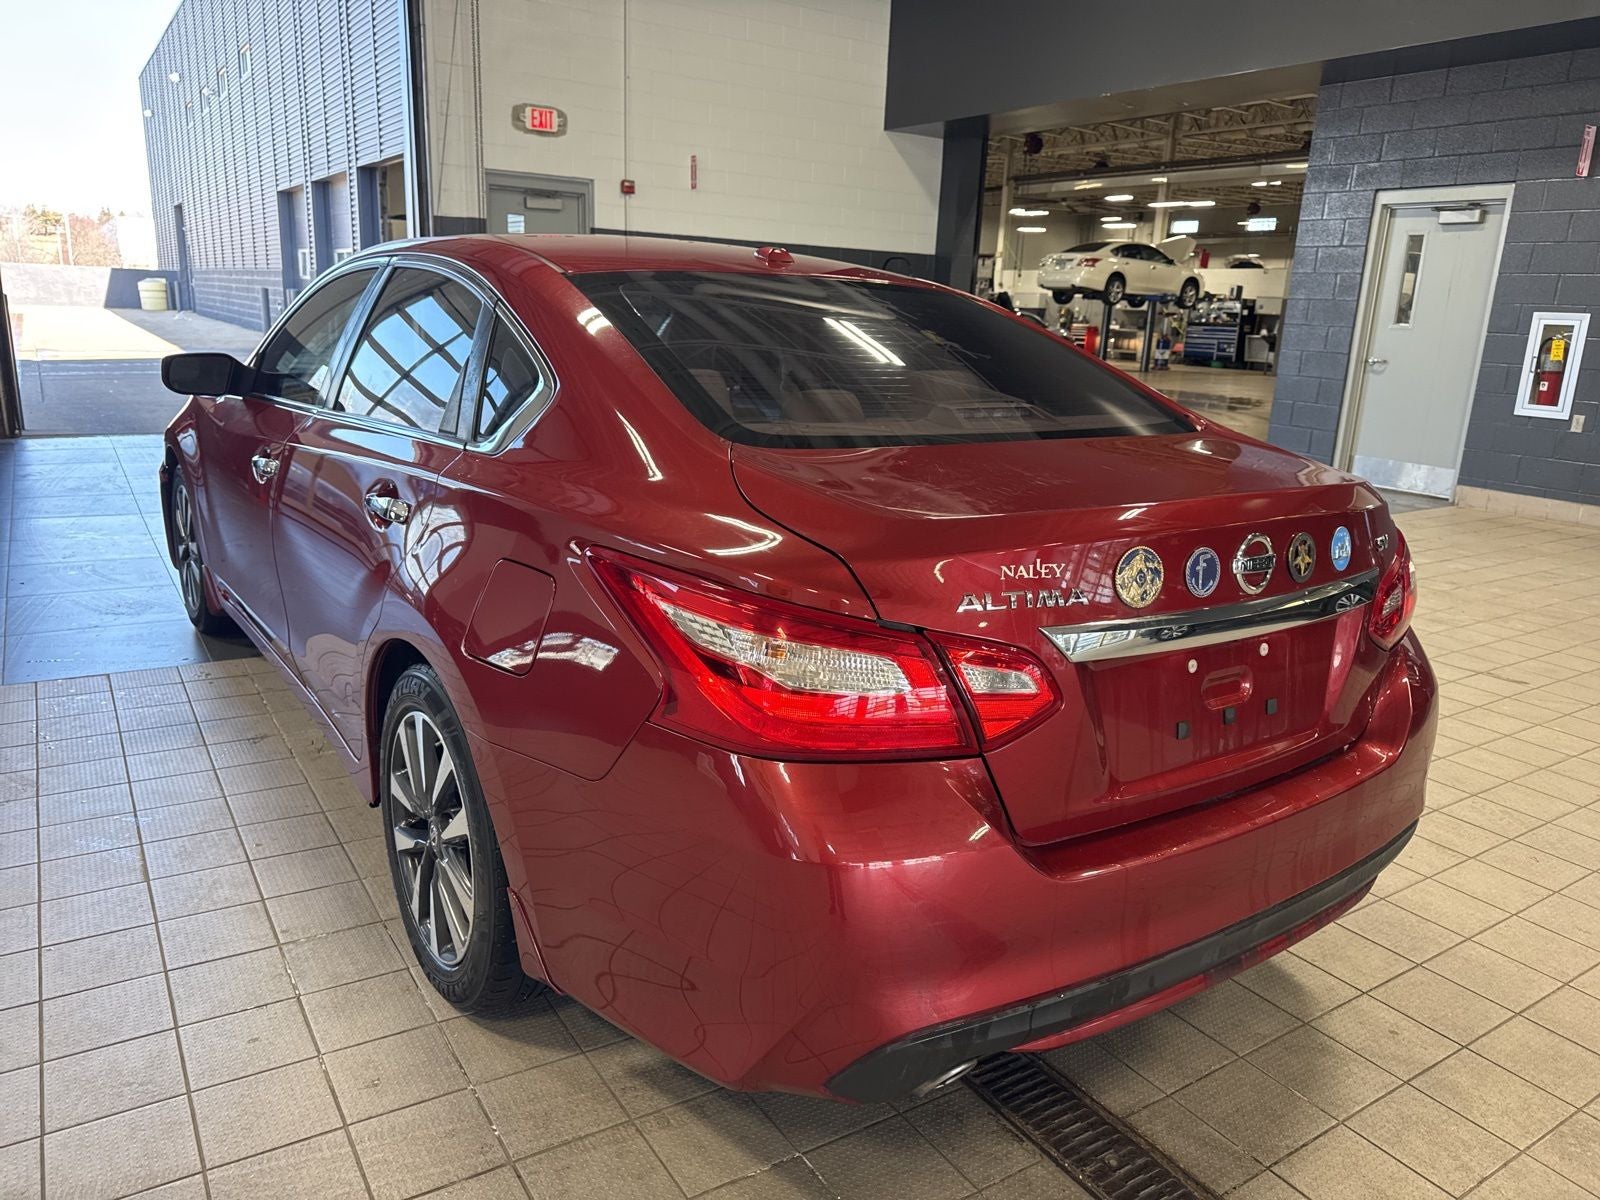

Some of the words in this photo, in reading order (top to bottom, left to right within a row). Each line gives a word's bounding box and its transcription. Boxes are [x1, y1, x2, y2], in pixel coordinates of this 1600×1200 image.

[531, 108, 554, 130] EXIT
[1000, 558, 1066, 580] NALLEY
[956, 588, 1090, 613] ALTIMA
